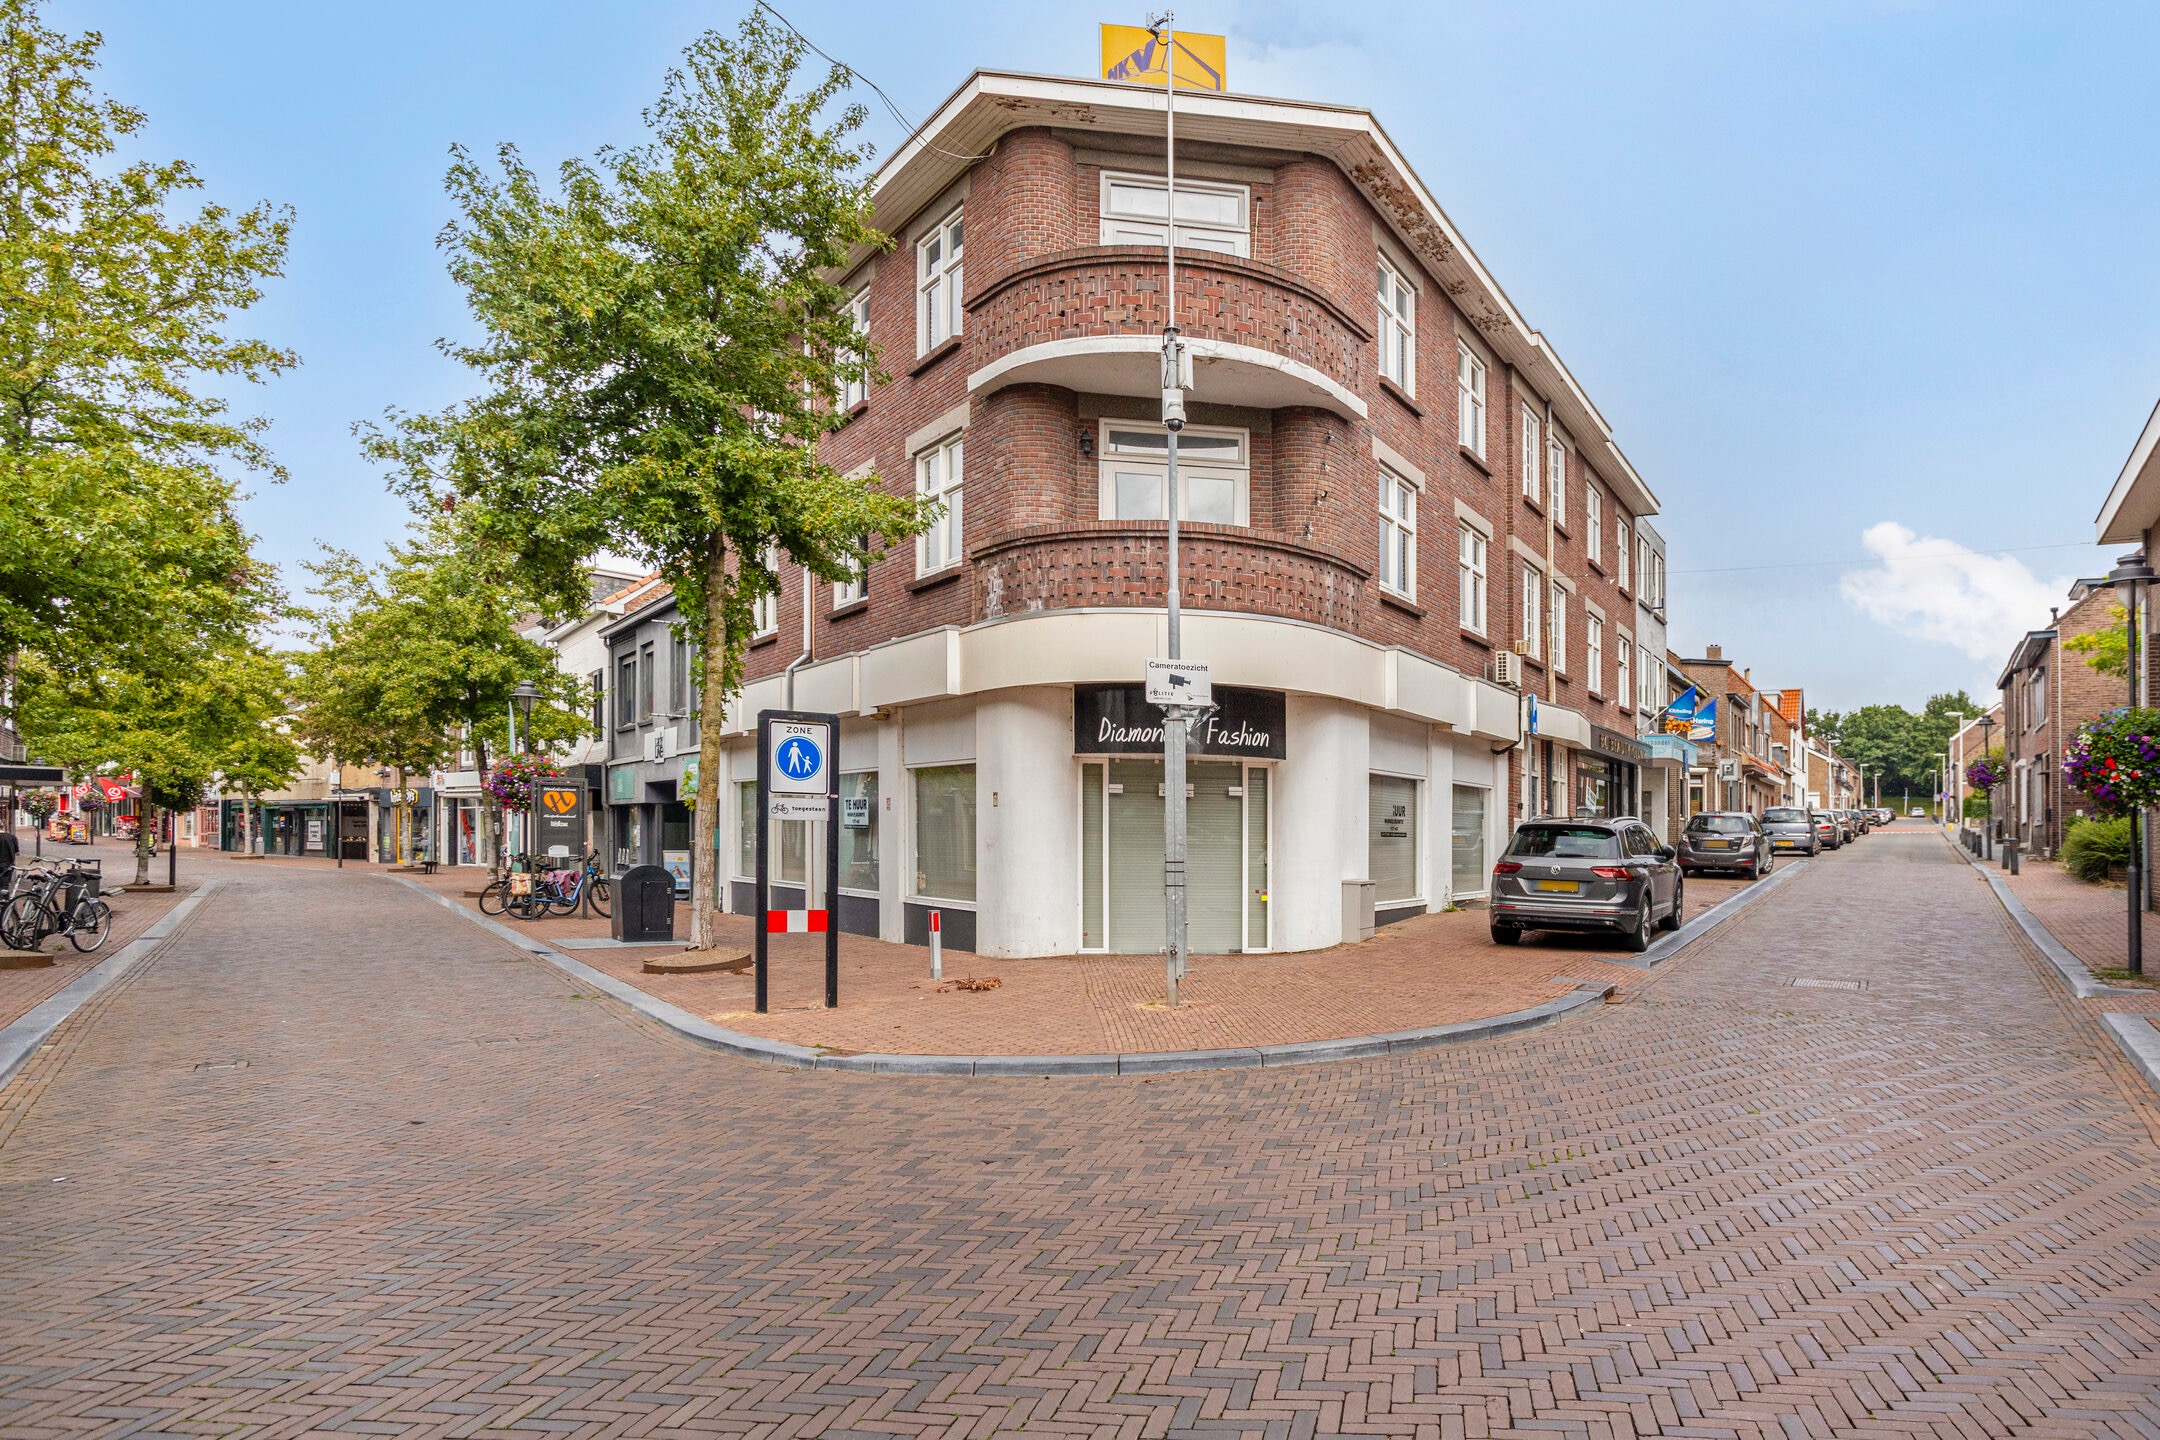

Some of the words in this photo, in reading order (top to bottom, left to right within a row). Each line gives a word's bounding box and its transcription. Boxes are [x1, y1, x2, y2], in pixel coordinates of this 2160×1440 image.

[1149, 661, 1208, 672] Cameratoezicht
[1693, 717, 1714, 725] Haring
[786, 726, 813, 735] ZONE
[1098, 716, 1166, 743] Diamon
[1206, 717, 1270, 748] Fashion
[845, 799, 851, 810] TE
[853, 799, 867, 810] HUUR
